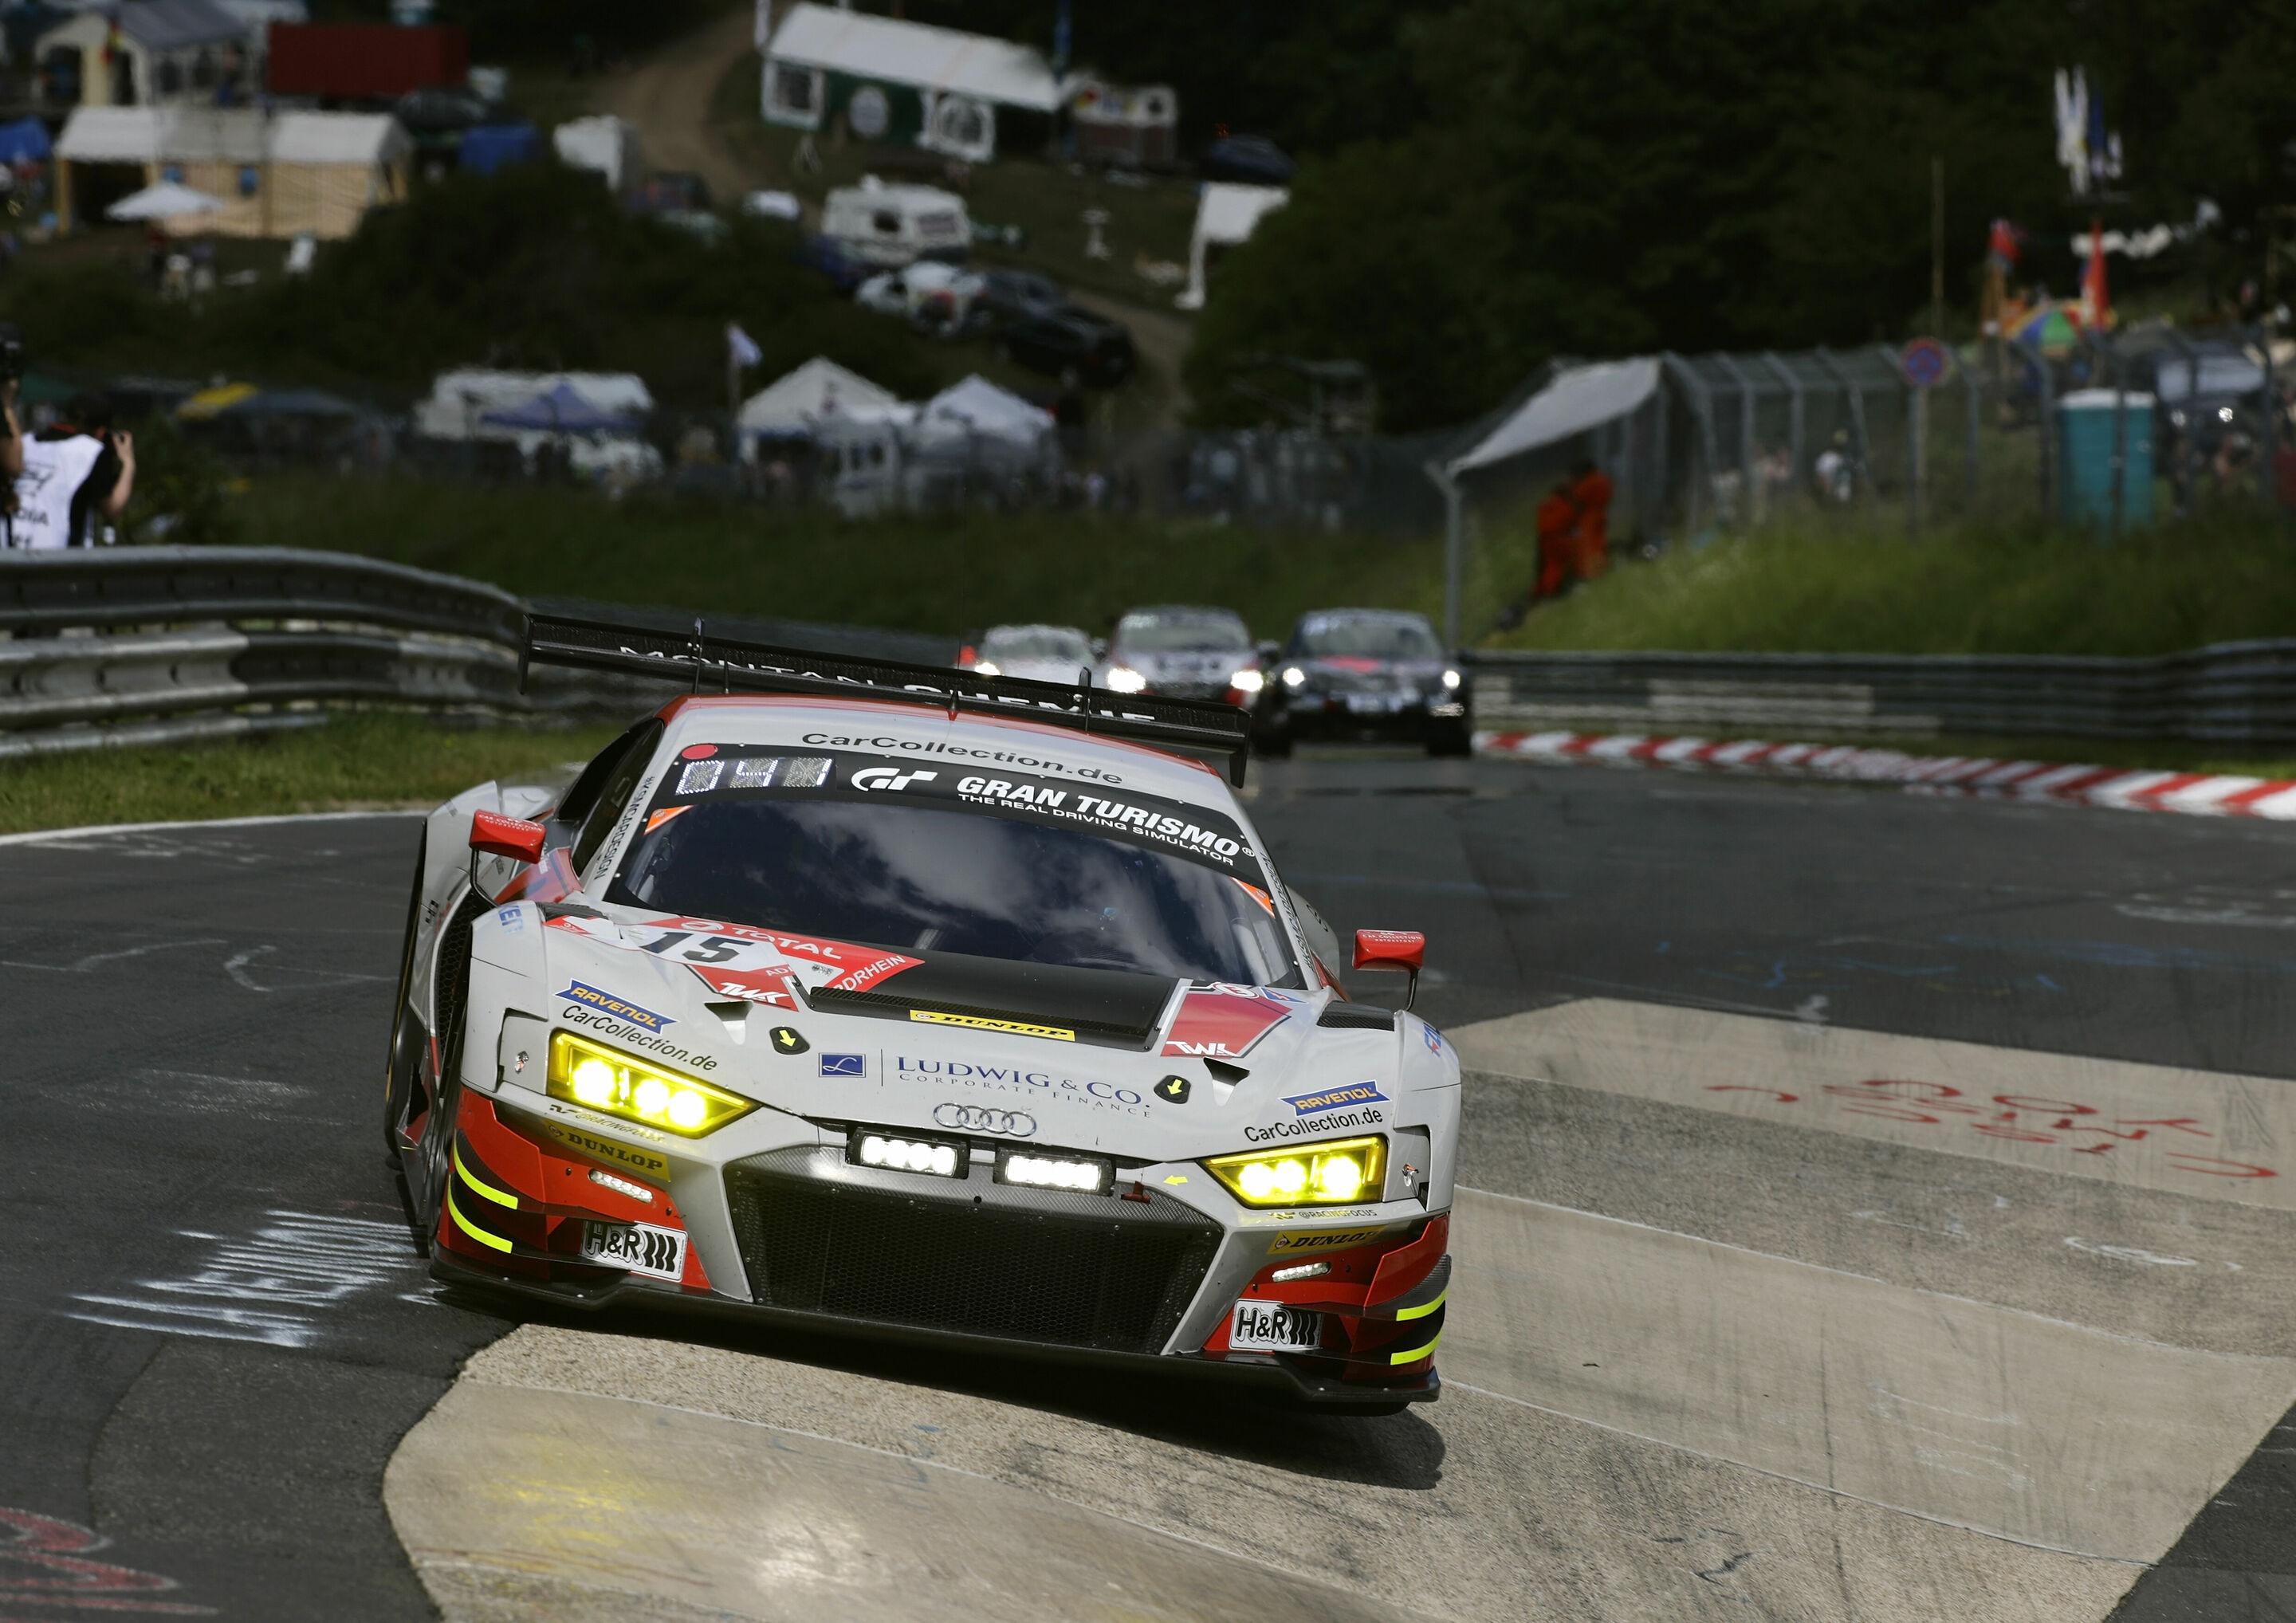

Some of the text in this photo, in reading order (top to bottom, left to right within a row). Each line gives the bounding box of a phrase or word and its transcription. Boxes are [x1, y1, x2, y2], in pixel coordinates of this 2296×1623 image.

[801, 733, 1123, 784] CarCollection.de
[957, 776, 1067, 808] GRAN
[957, 793, 1234, 867] THE REAL DRIVING SIMULATOR
[639, 931, 755, 963] 15
[732, 927, 842, 960] TOTAL
[570, 986, 658, 1028] RAVENOL
[561, 1004, 718, 1071] CarCollection.de
[940, 1017, 1068, 1035] DUNLOP
[895, 1055, 1051, 1088] LUDWIG
[899, 1073, 1151, 1118] CORPORATE FINANCE
[1295, 1087, 1378, 1110] RAVENOL
[1244, 1106, 1384, 1142] CarCollection.de
[568, 1132, 664, 1171] DUNLOP
[1298, 1208, 1378, 1220] @RACINGFOCUS
[586, 1220, 641, 1260] H&R
[1236, 1308, 1288, 1340] H&R
